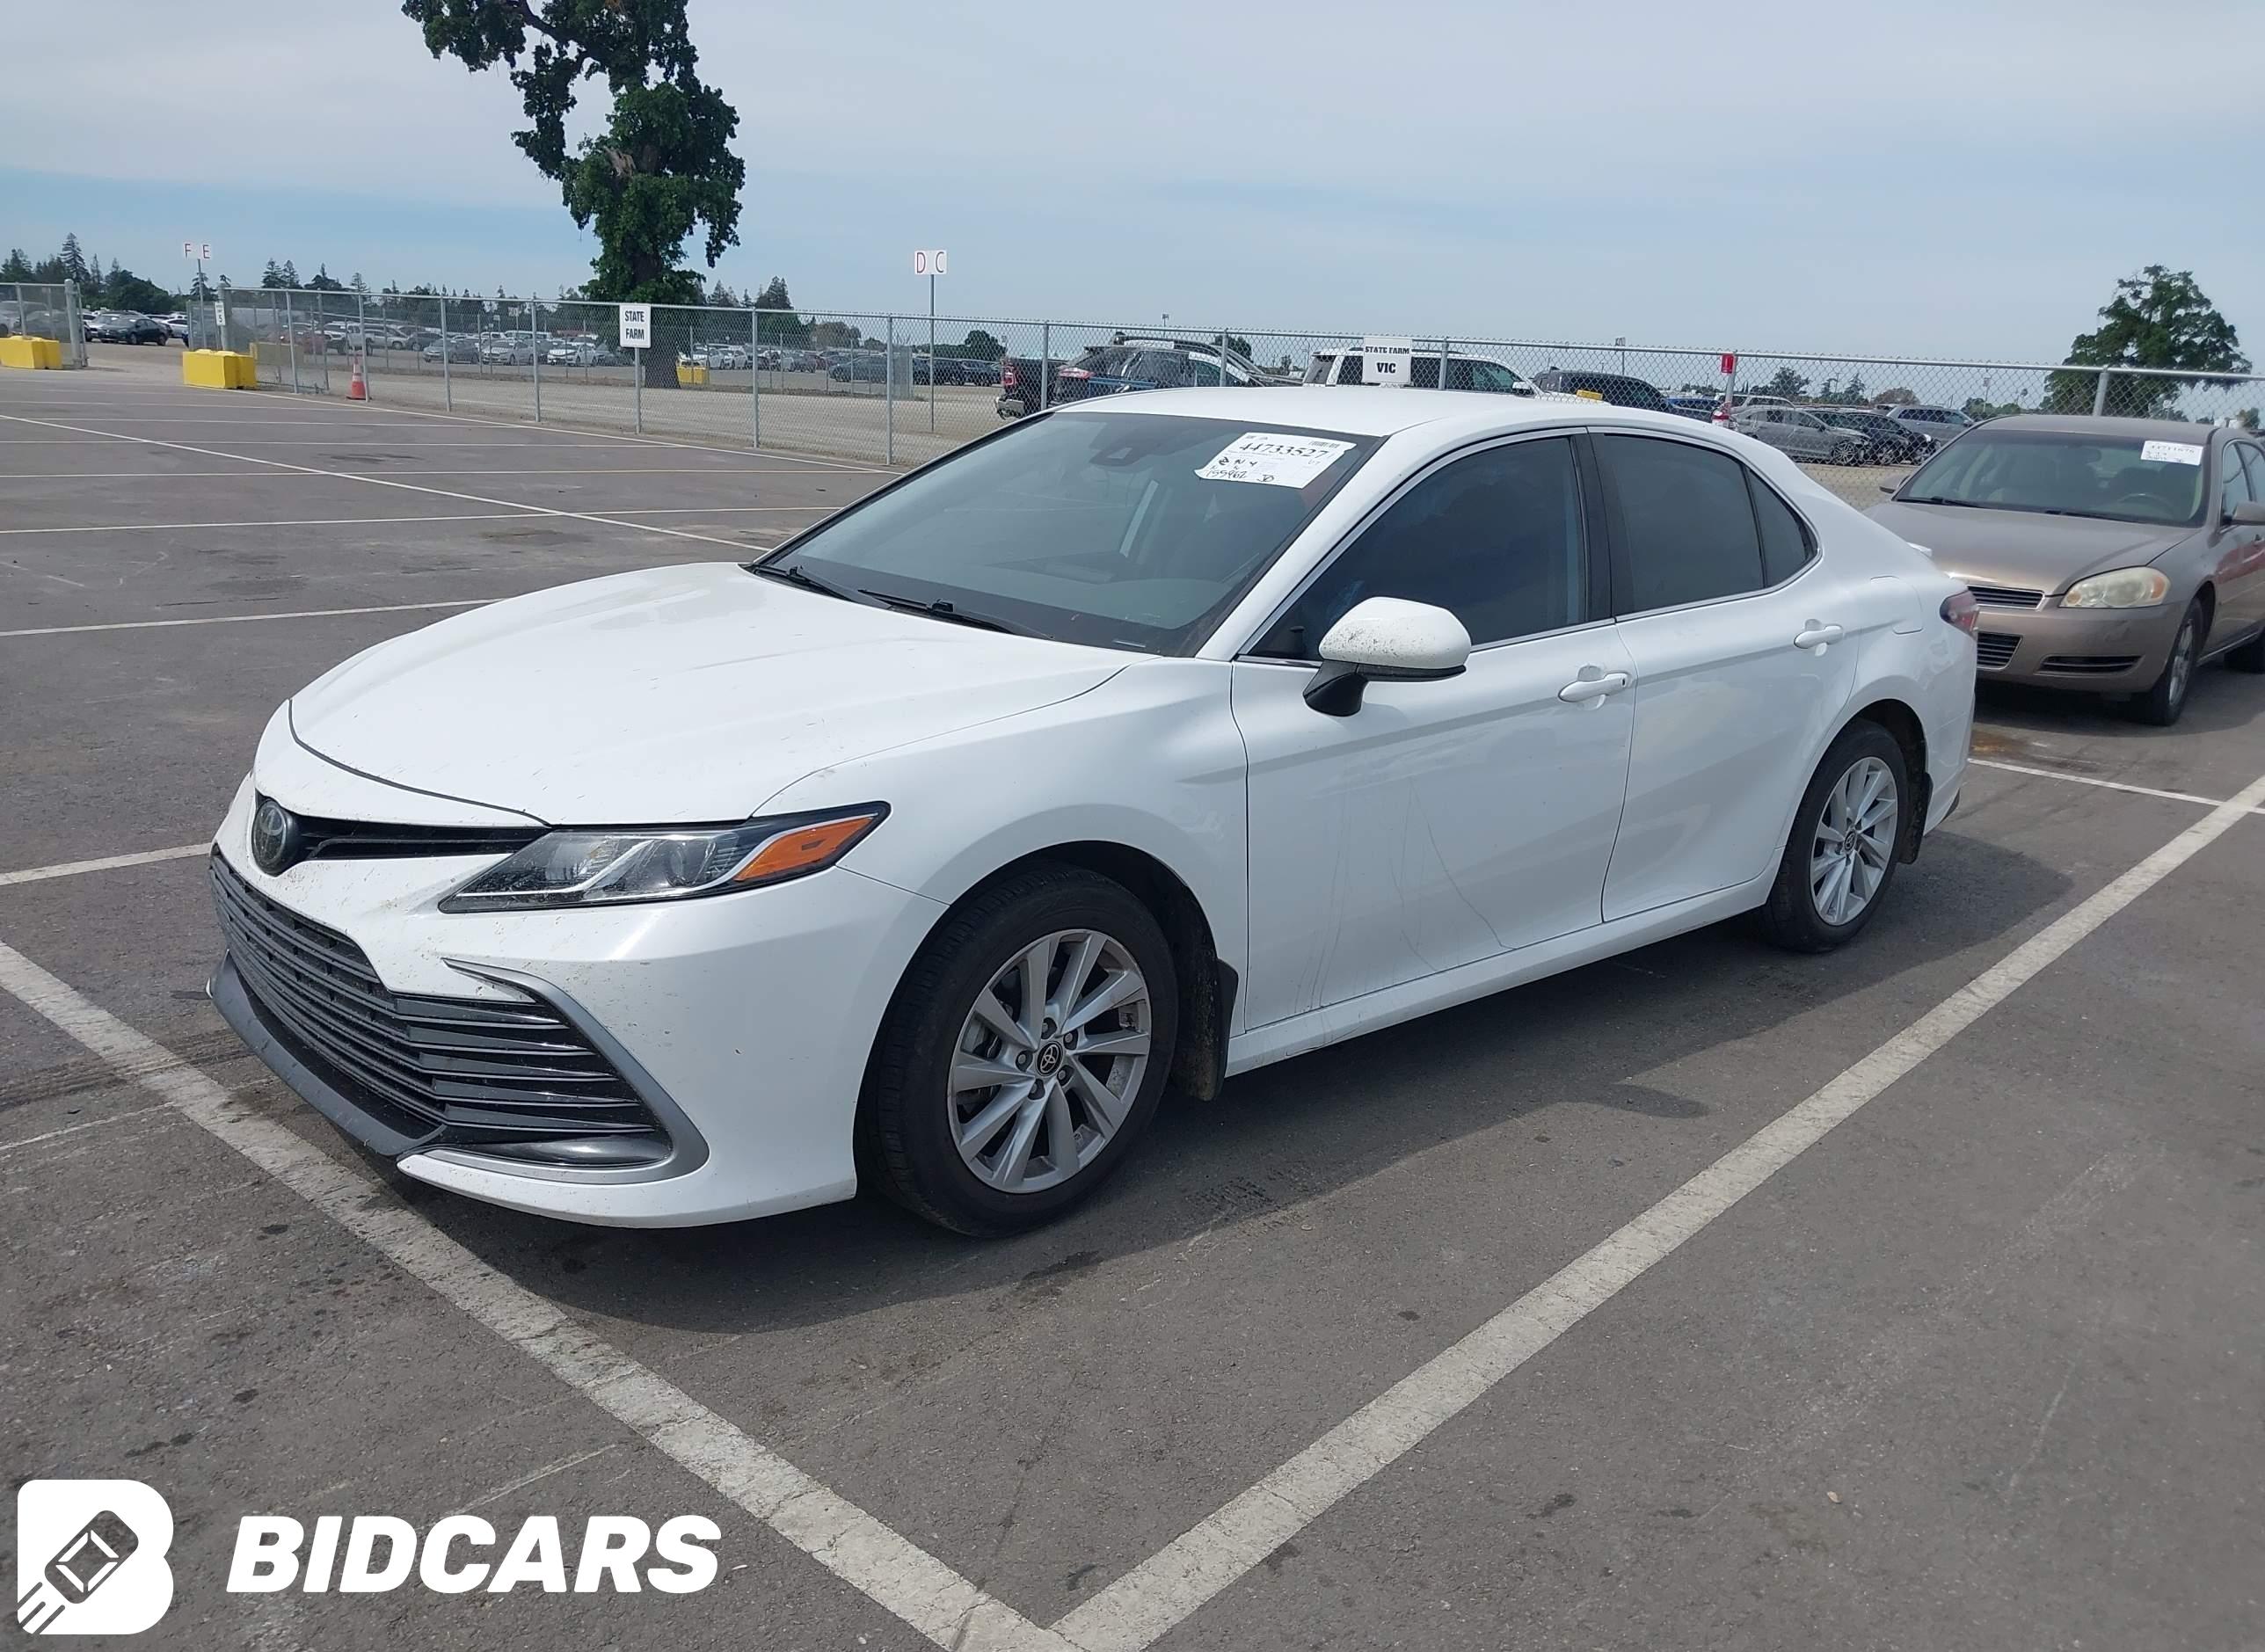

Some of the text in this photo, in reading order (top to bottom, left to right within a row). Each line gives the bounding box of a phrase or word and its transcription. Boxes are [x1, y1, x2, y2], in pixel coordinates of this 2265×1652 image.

[185, 244, 210, 258] F E
[916, 251, 944, 273] D C
[624, 310, 645, 322] STATE
[625, 328, 645, 340] FARM
[1376, 362, 1396, 374] VIC
[1239, 442, 1329, 458] 44733527
